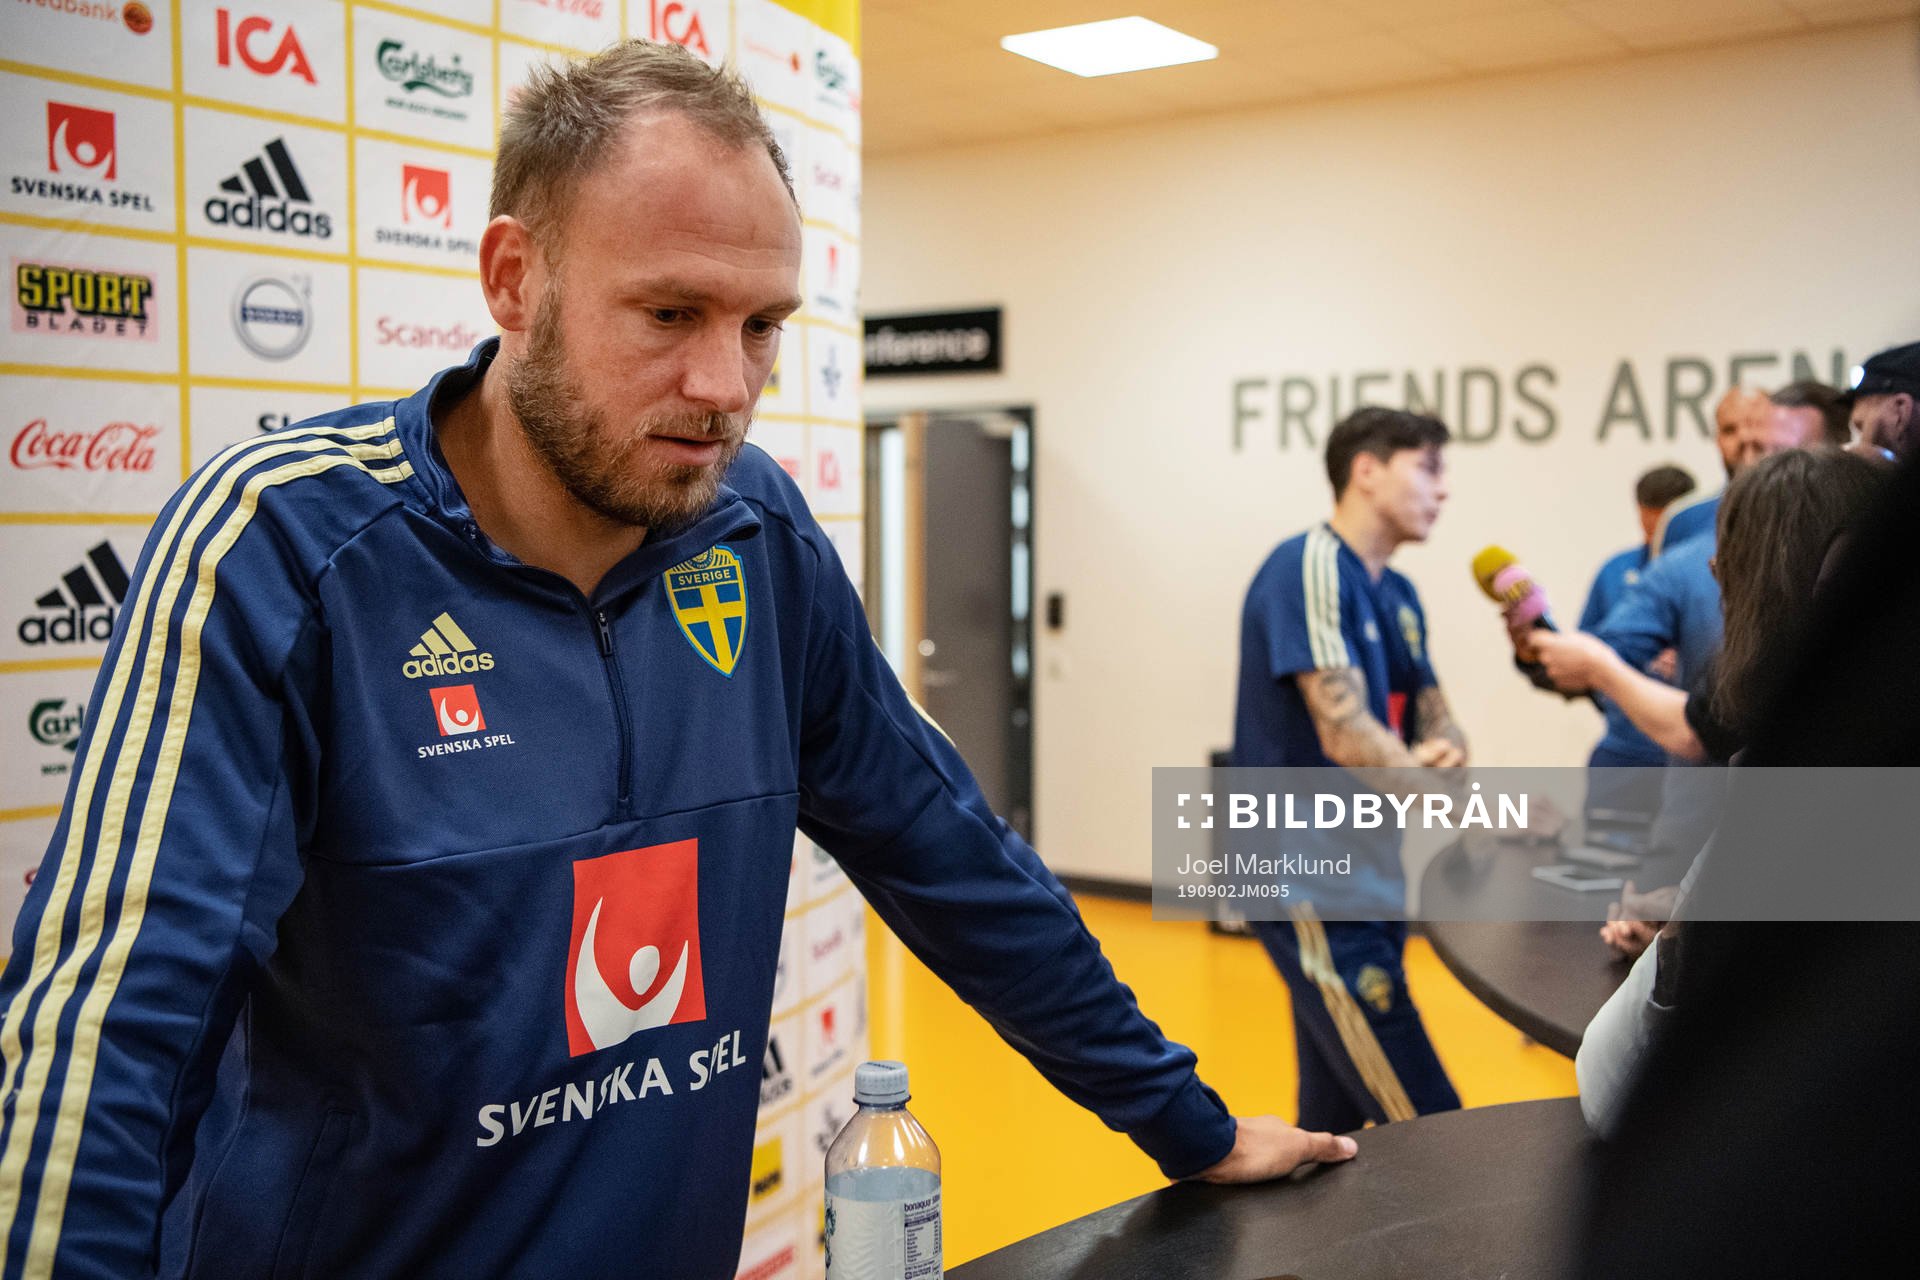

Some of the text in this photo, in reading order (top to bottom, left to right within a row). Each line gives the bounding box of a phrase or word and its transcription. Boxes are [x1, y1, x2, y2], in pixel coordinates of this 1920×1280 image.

[216, 8, 318, 85] ICA
[649, 0, 710, 55] ICA
[11, 175, 154, 213] SVENSKA SPEL
[204, 197, 332, 239] adidas
[17, 263, 153, 320] SPORT
[26, 313, 148, 335] BLADET
[10, 416, 161, 473] Coca-Cola
[678, 569, 731, 586] SVERIGE
[402, 650, 495, 679] adidas
[417, 732, 515, 759] SVENSKA SPEL
